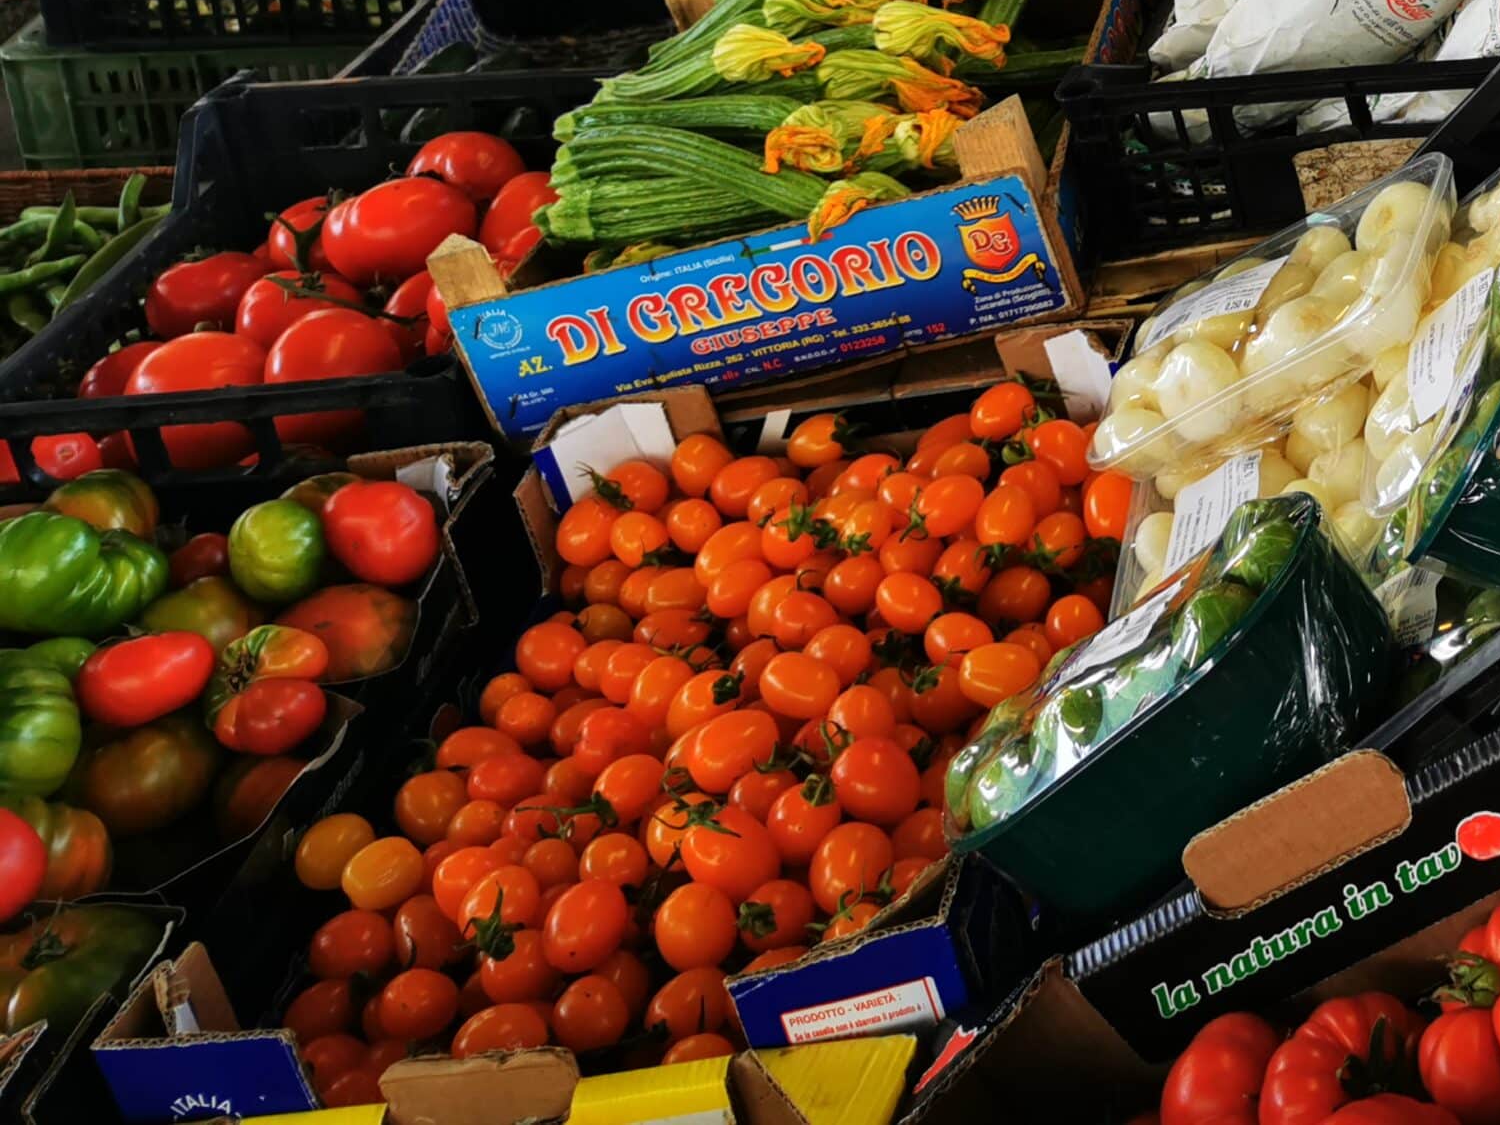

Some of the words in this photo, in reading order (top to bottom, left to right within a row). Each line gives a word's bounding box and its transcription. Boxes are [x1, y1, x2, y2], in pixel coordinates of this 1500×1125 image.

[674, 261, 703, 276] ITALIA
[546, 306, 626, 366] DI
[626, 230, 942, 344] GREGORIO
[689, 306, 837, 356] GIUSEPPE
[926, 322, 946, 334] 152
[518, 355, 553, 377] AZ.
[615, 383, 633, 393] Via
[752, 341, 800, 359] VITTORIA
[801, 334, 825, 347] (RG)
[1152, 981, 1200, 1019] la
[1202, 905, 1342, 994] natura
[1343, 879, 1392, 920] in
[788, 1006, 846, 1027] PRODOTTO
[853, 991, 896, 1013] VARIETÀ
[170, 1093, 232, 1115] ITALIA
